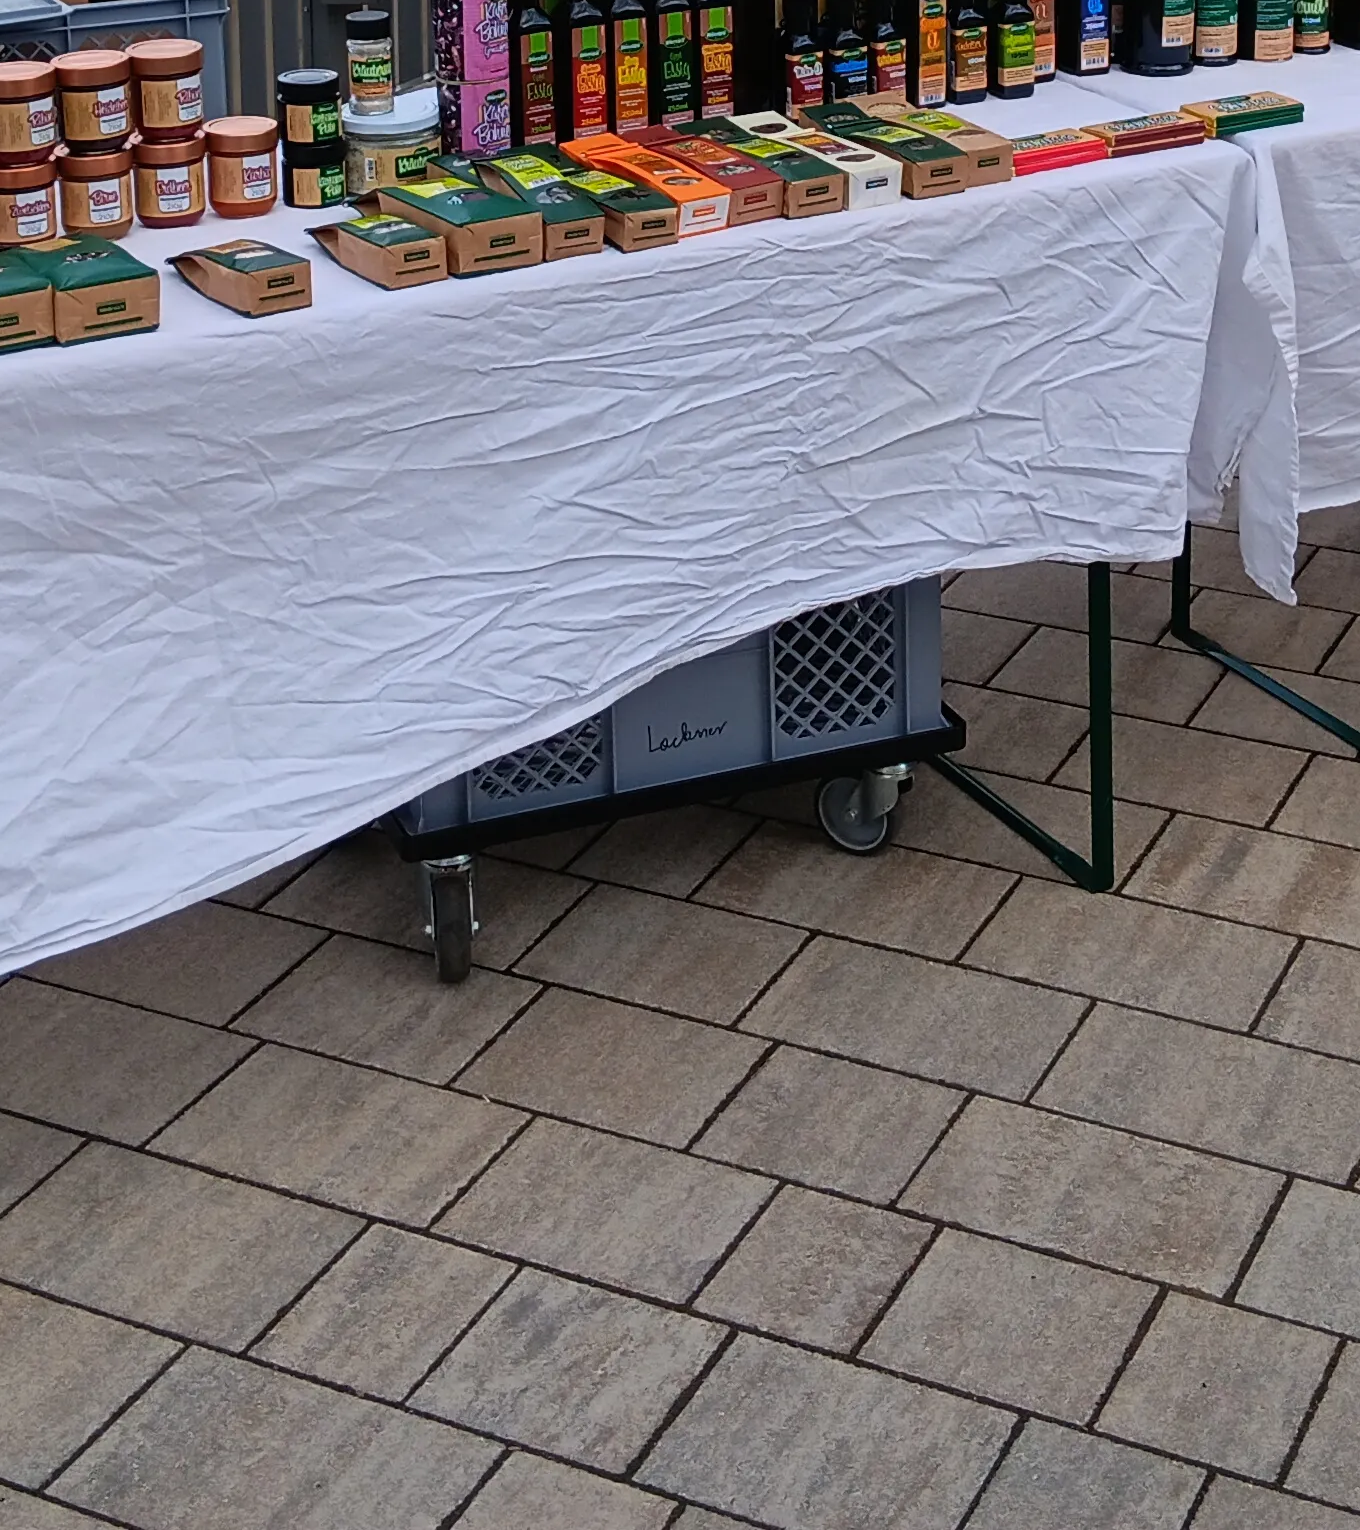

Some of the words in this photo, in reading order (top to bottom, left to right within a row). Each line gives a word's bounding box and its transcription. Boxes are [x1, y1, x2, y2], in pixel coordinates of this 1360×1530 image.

[663, 61, 691, 80] Essig
[704, 53, 732, 73] Essig
[527, 82, 554, 102] Essig
[577, 73, 606, 95] Essig
